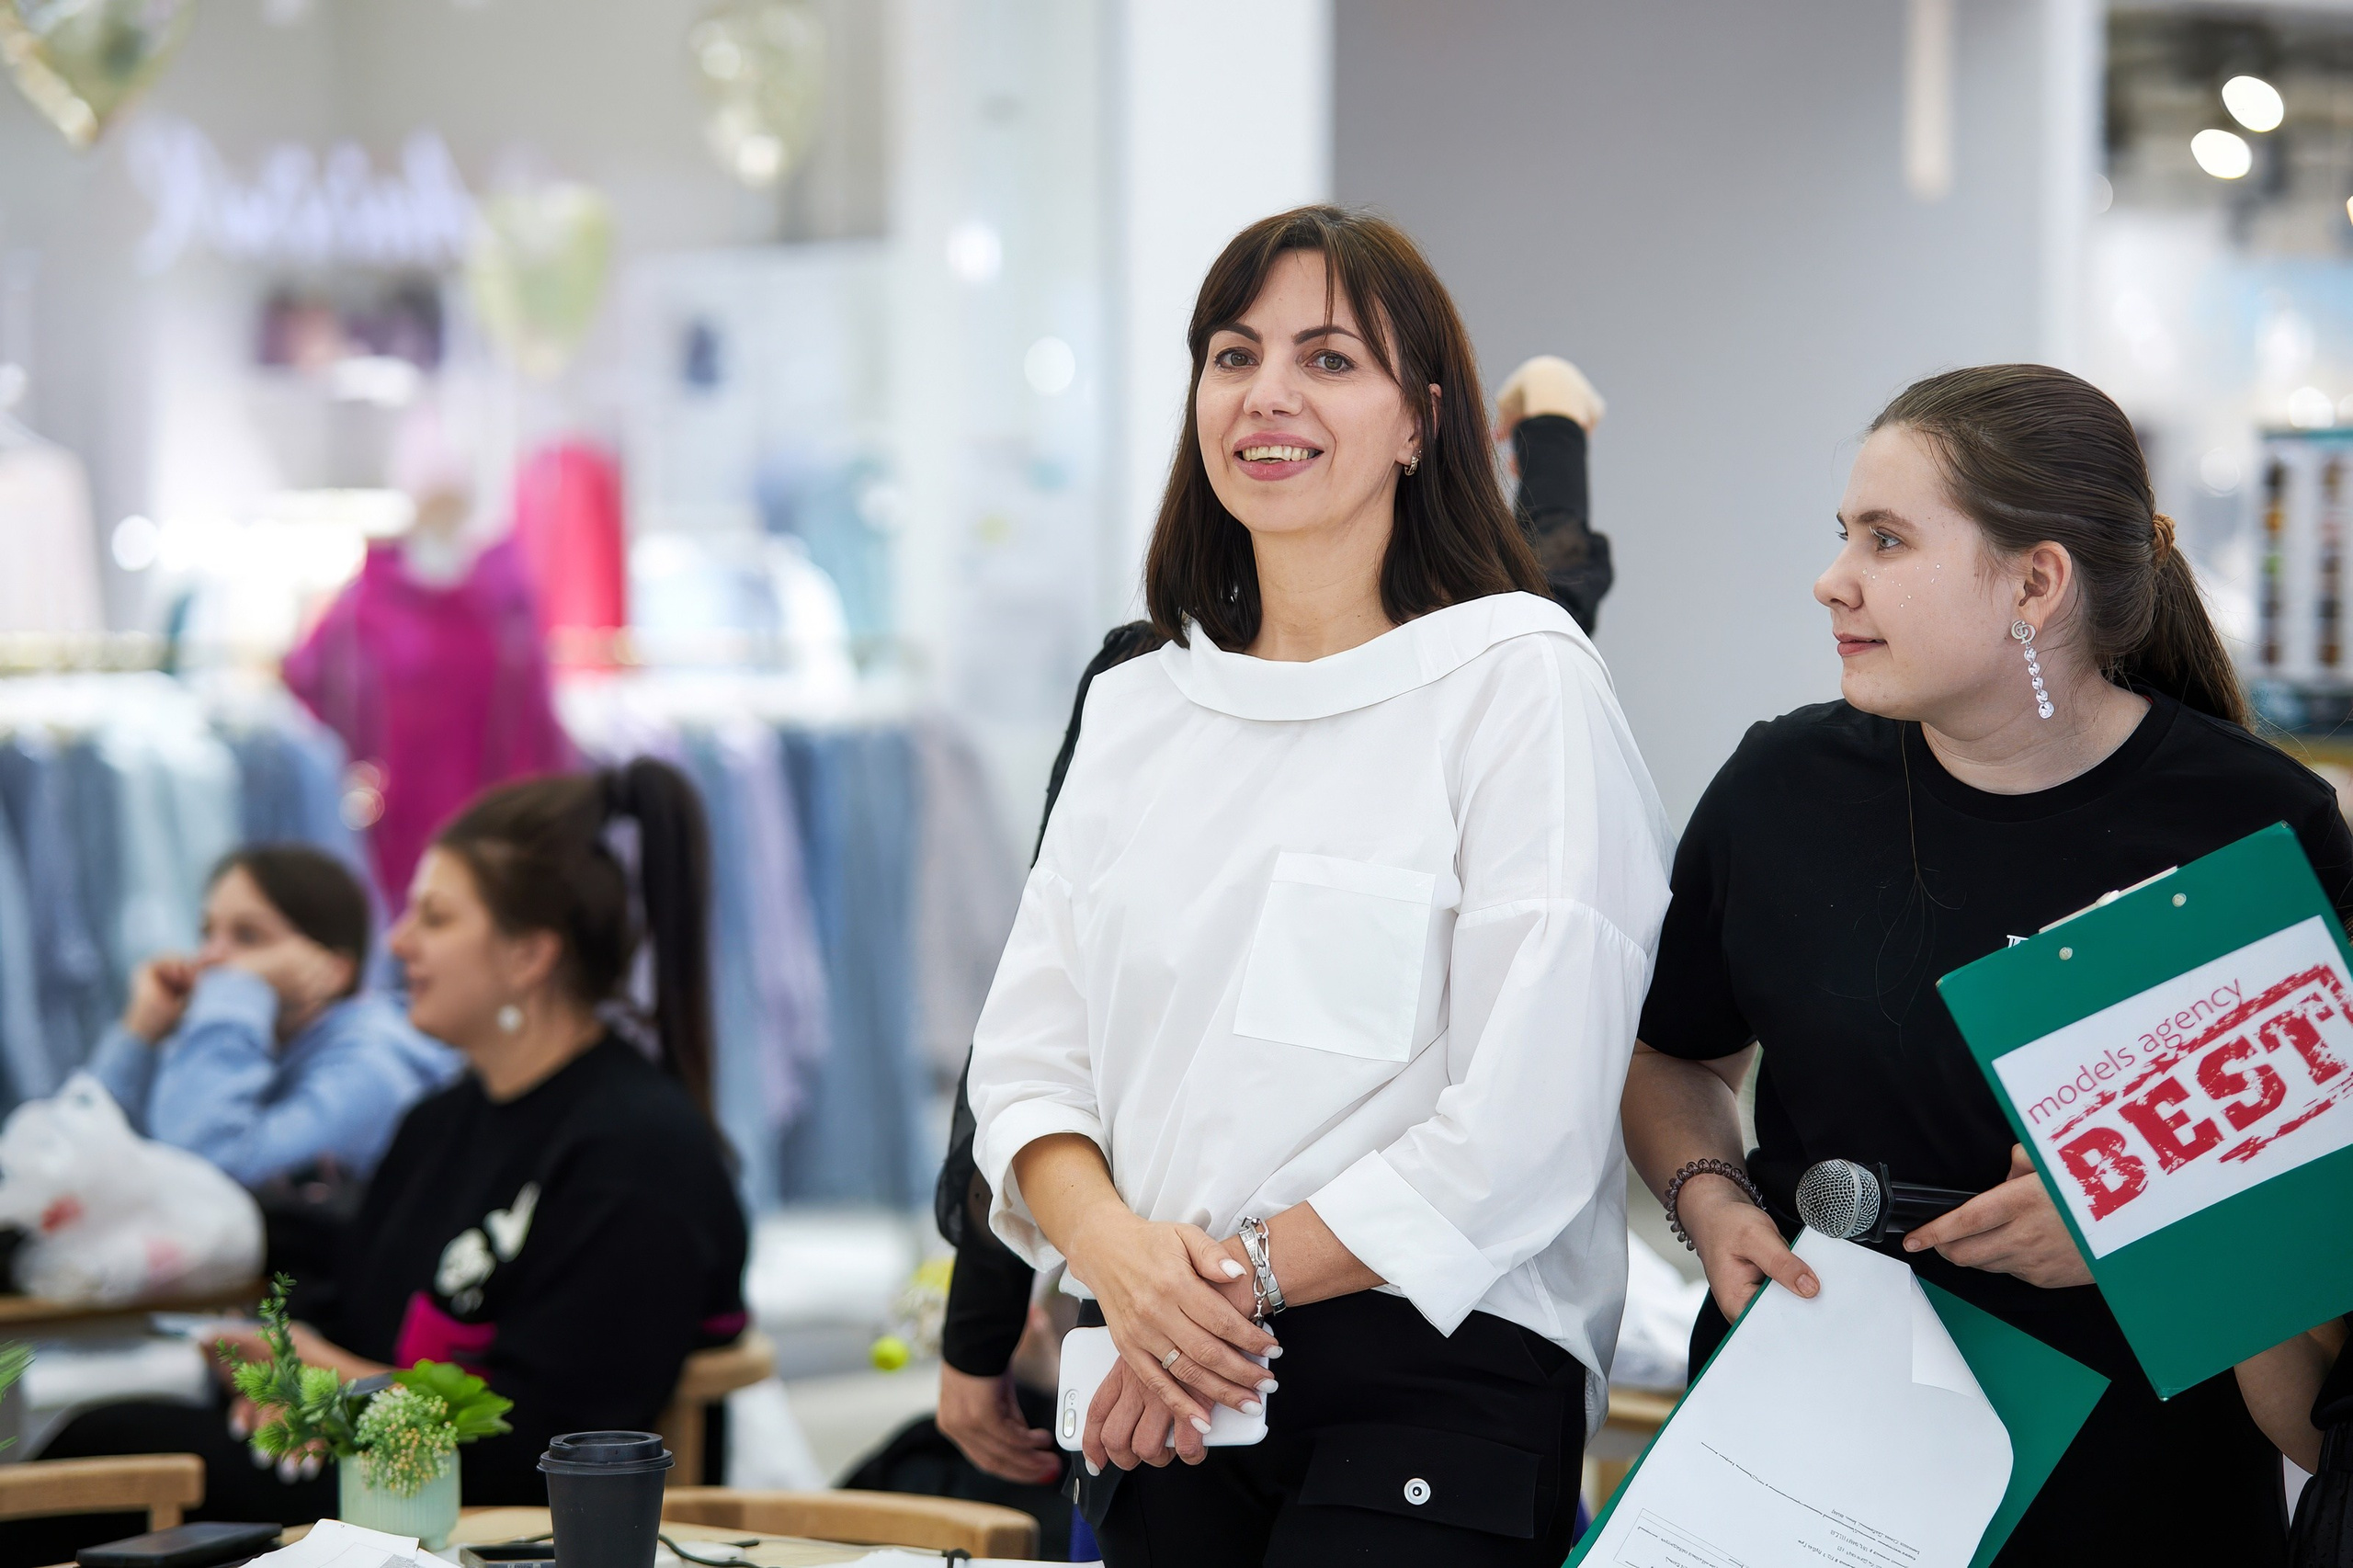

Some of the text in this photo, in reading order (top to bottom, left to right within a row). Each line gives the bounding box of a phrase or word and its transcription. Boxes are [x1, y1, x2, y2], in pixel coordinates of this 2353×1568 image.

[2027, 977, 2244, 1125] models agency
[2056, 991, 2346, 1222] BEST
